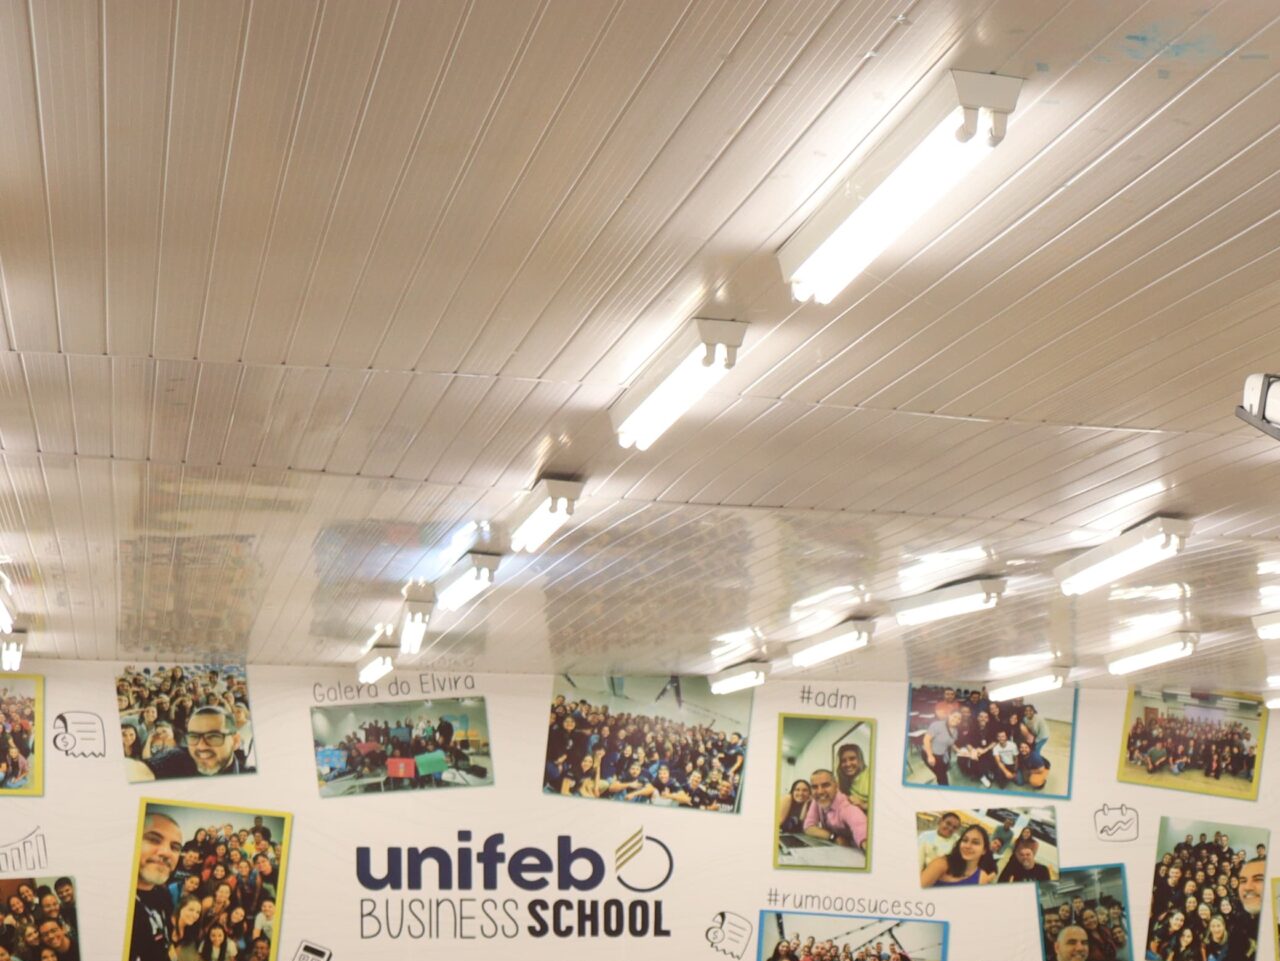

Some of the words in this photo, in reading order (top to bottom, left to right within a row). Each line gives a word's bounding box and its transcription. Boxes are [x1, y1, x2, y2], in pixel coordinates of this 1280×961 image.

[313, 681, 379, 704] Galera
[388, 676, 411, 697] do
[419, 672, 476, 694] Elvira
[800, 684, 857, 711] #adm
[355, 829, 606, 892] unifeb
[360, 898, 520, 939] BUSINESS
[527, 899, 671, 938] SCHOOL
[767, 887, 937, 918] #rumoaosucesso
